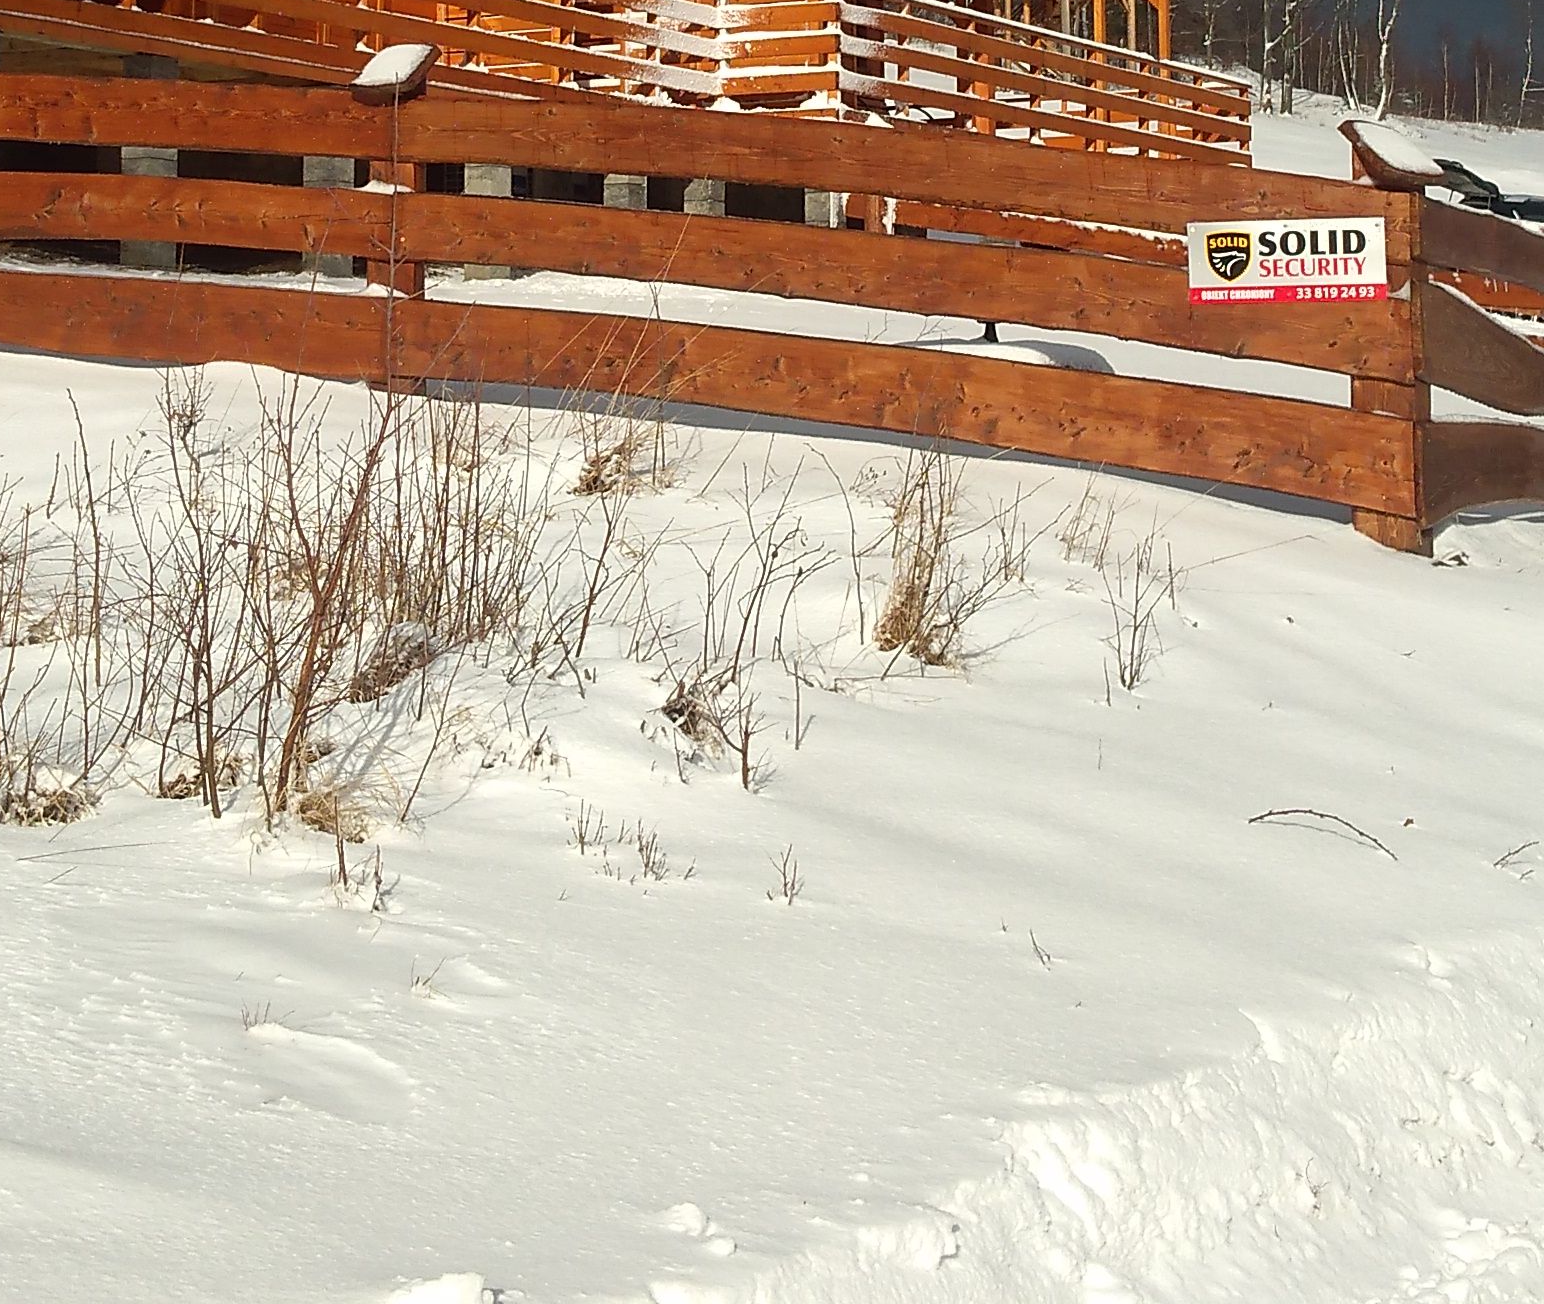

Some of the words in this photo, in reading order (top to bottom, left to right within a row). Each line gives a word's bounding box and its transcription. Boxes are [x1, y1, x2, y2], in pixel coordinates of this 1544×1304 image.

[1208, 236, 1248, 249] SOLID
[1258, 229, 1366, 257] SOLID
[1258, 256, 1367, 278] SECURITY
[1296, 287, 1313, 299] 33
[1314, 287, 1337, 299] 819
[1340, 286, 1358, 298] 24
[1358, 286, 1375, 298] 93
